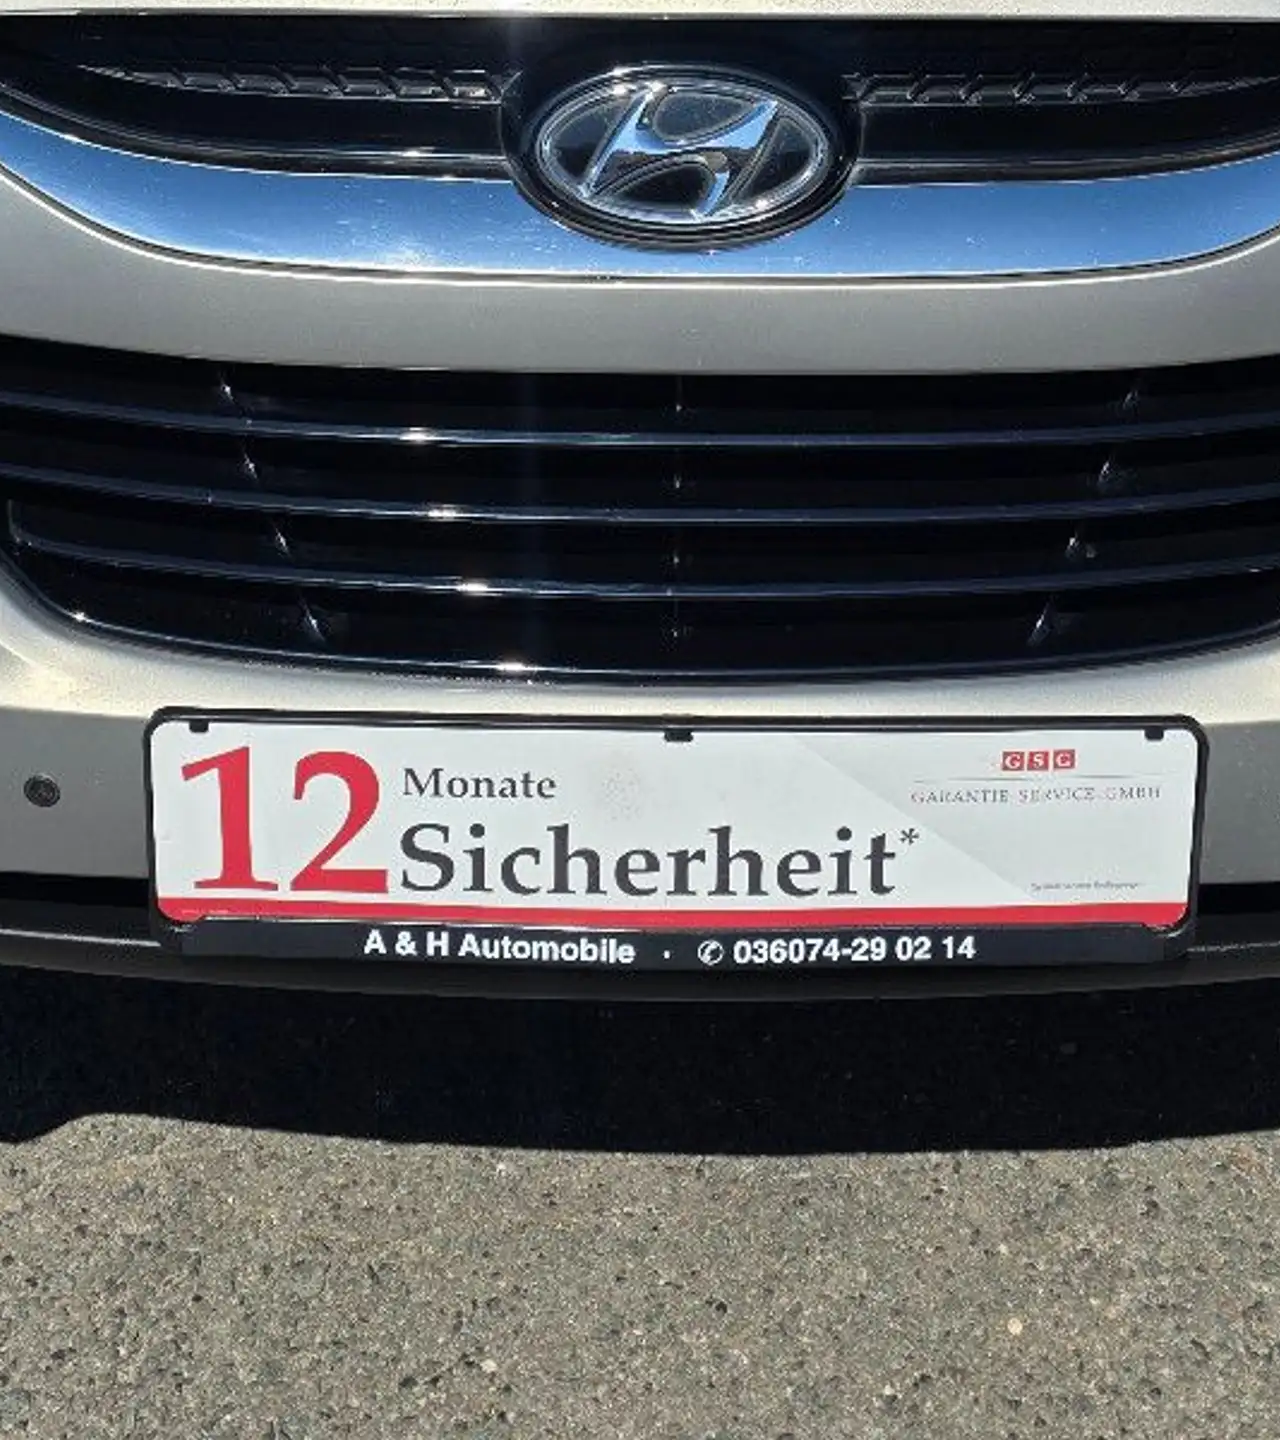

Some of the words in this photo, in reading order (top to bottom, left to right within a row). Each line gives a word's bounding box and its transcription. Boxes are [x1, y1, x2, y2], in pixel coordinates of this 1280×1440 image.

[401, 766, 557, 799] Monate
[911, 789, 1009, 804] GARANTIE
[1019, 787, 1095, 803] SERVICE
[181, 746, 389, 894] 12
[363, 929, 387, 955] A
[395, 931, 418, 957] &
[426, 931, 450, 957] H
[458, 933, 636, 964] Automobile
[733, 935, 887, 964] 036074-29
[894, 935, 932, 961] 02
[942, 935, 976, 959] 14
